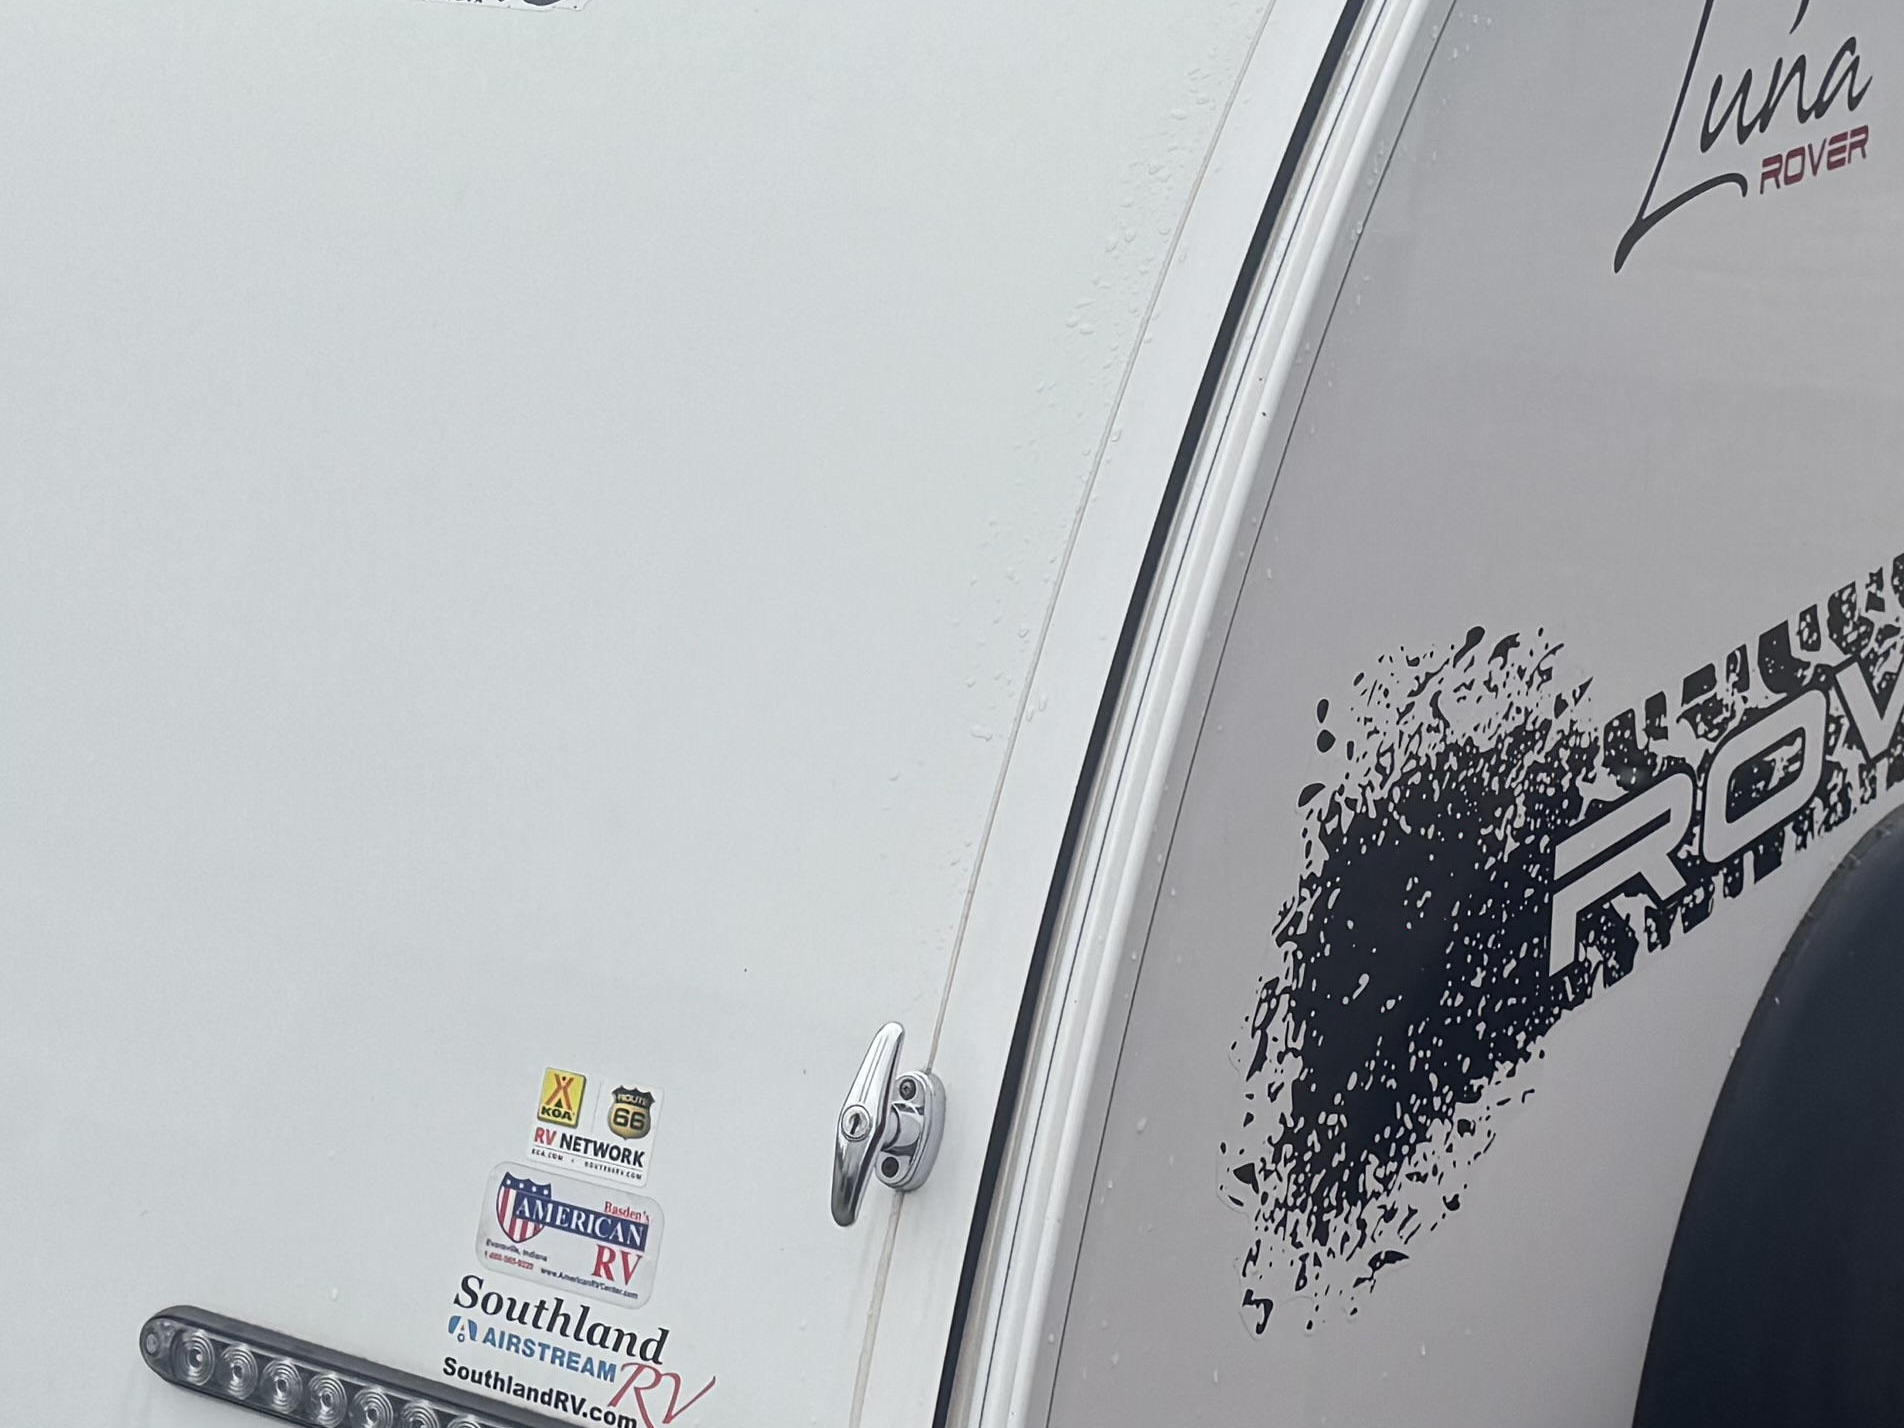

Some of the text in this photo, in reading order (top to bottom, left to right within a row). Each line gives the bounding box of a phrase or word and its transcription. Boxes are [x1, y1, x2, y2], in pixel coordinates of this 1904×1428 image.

[1759, 124, 1869, 195] ROVER
[540, 1105, 574, 1122] KOA
[612, 1107, 646, 1131] 66
[615, 1091, 650, 1107] ROUTE
[533, 1126, 646, 1168] RV NETWORK
[515, 1196, 645, 1246] AMERICAN
[591, 1243, 644, 1286] RV
[453, 1274, 670, 1365] Southland
[481, 1326, 618, 1384] AIRSTREAM
